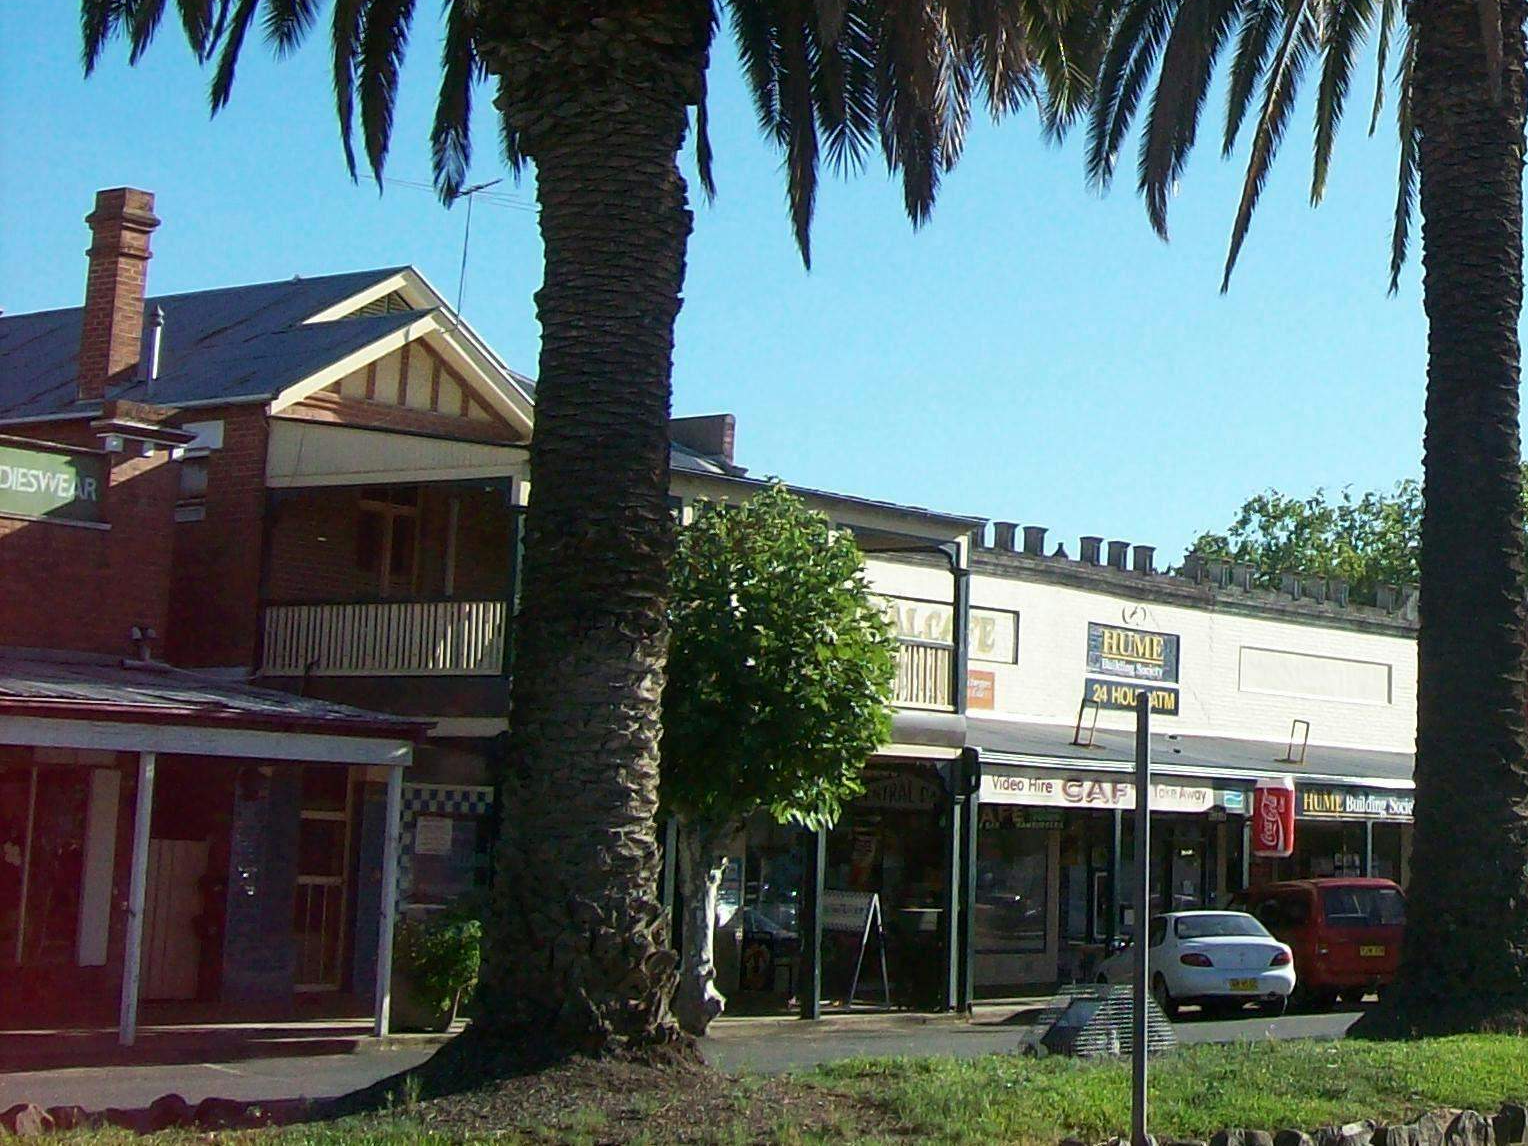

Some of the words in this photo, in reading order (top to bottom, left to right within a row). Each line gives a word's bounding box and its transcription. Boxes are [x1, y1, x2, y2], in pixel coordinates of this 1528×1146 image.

[1103, 629, 1164, 660] HUME
[1101, 657, 1136, 677] Building
[1136, 662, 1164, 681] Society
[1093, 684, 1108, 704] 24
[1111, 685, 1146, 707] HOU
[1150, 690, 1175, 710] ATM
[992, 774, 1025, 792] Video
[1028, 777, 1053, 794] Hire
[1061, 777, 1136, 805] CAF
[1153, 785, 1177, 800] Take
[1178, 786, 1207, 805] Away
[1303, 791, 1344, 812] HUME
[1345, 794, 1387, 816] Building
[1388, 796, 1415, 816] Socie
